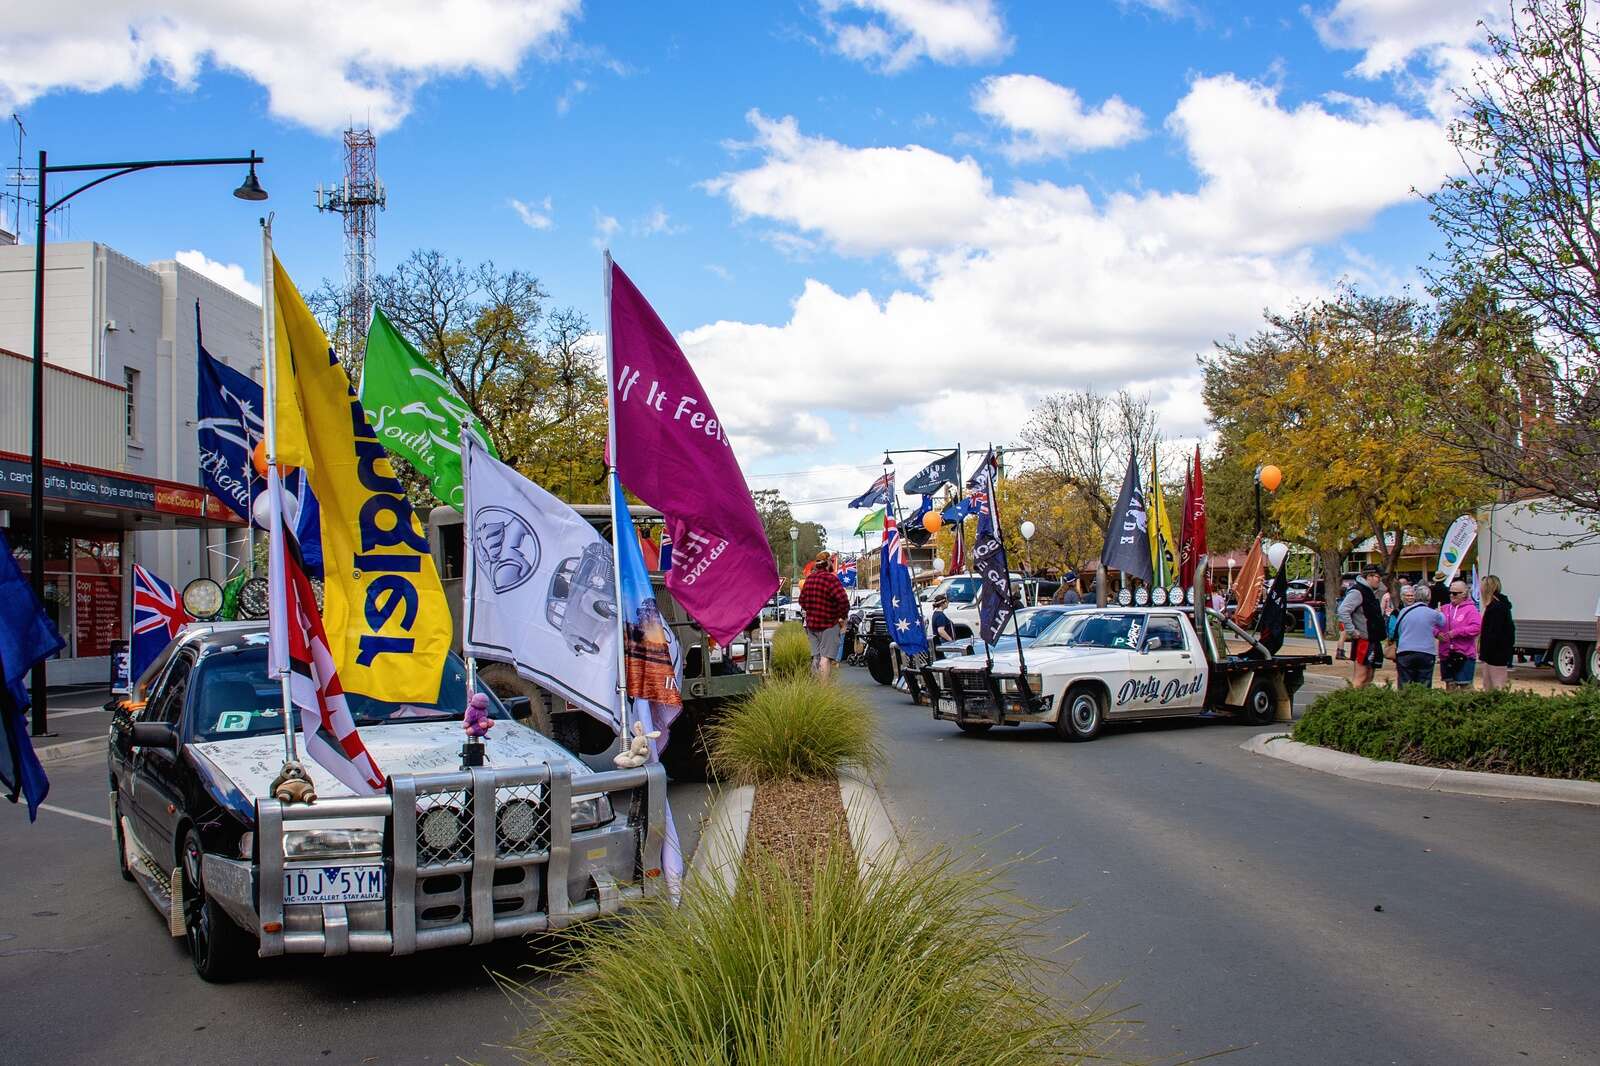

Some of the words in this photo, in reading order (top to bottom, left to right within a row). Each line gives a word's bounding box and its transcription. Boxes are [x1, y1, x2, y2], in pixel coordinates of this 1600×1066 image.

[617, 365, 640, 402] If
[646, 381, 668, 412] It
[10, 471, 32, 483] card
[44, 475, 68, 489] gifts,
[70, 478, 99, 494] books,
[100, 484, 118, 496] toys
[119, 487, 136, 498] and
[77, 580, 92, 591] Copy
[77, 593, 92, 604] Shop
[1114, 638, 1125, 646] P
[1116, 676, 1160, 706] Dirty
[1160, 673, 1203, 704] Devil
[224, 714, 244, 729] P
[285, 873, 323, 896] 1DJ
[341, 870, 381, 894] 5YM
